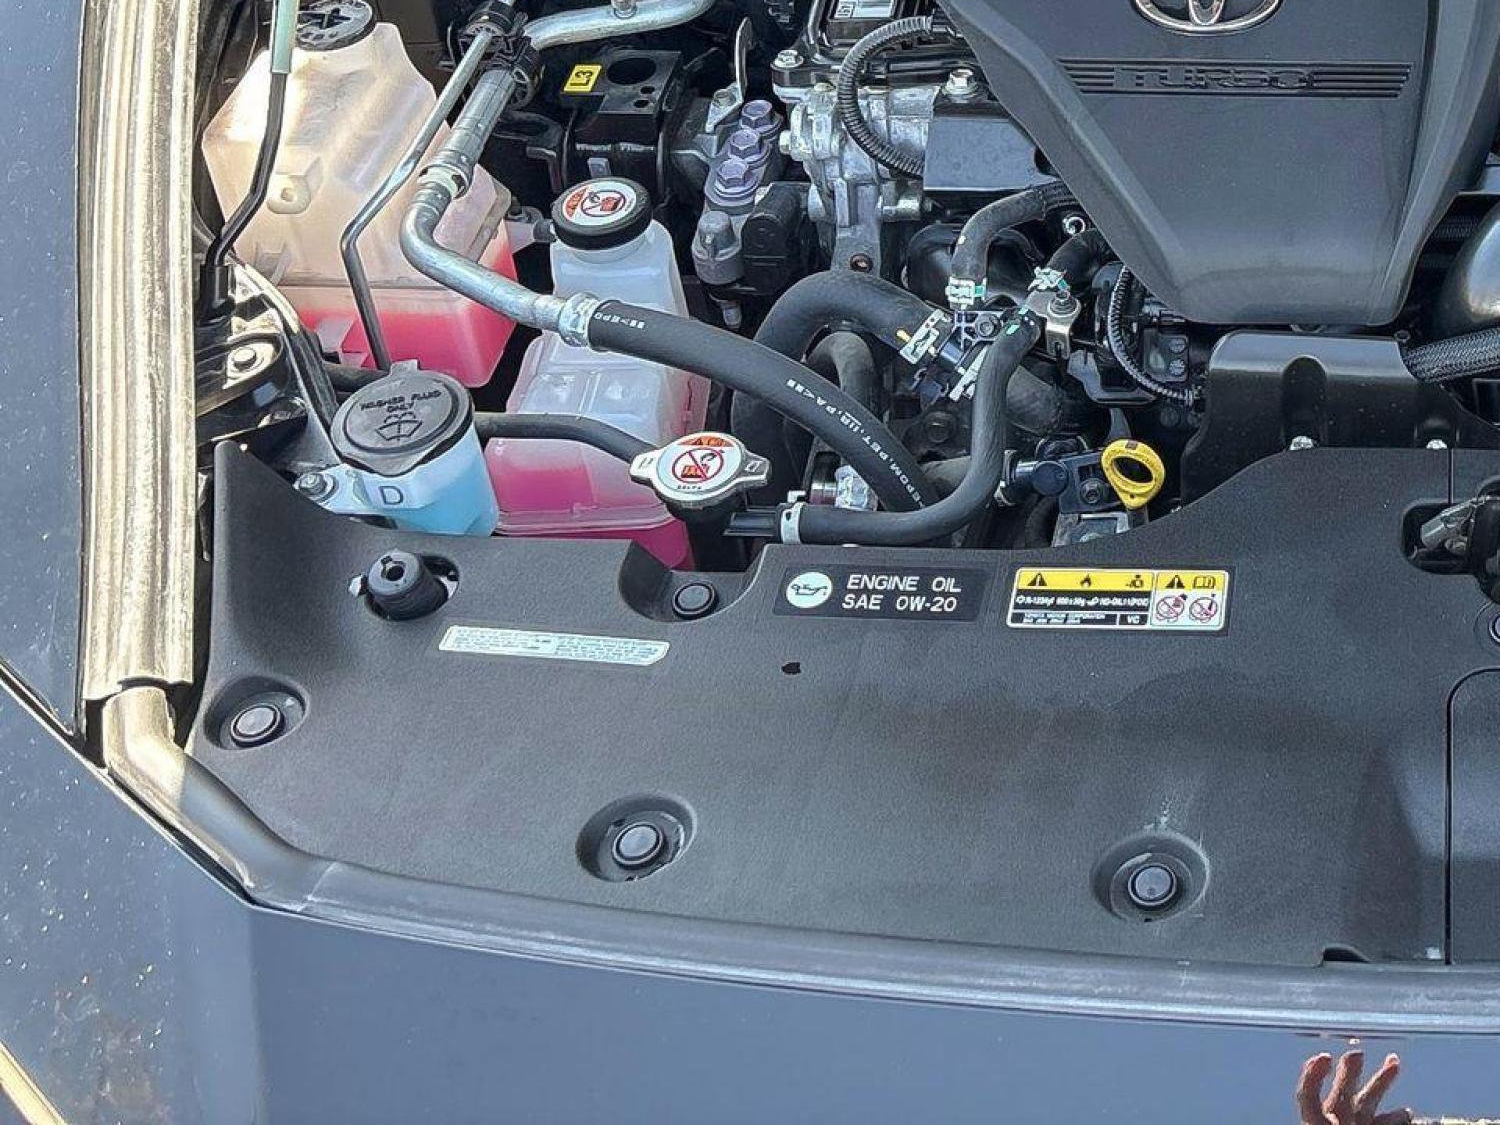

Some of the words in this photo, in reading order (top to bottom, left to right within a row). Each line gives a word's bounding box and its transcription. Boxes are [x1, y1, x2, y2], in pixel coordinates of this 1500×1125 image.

[569, 70, 594, 87] L3
[379, 485, 404, 506] D
[846, 574, 918, 592] ENGINE
[931, 576, 962, 593] OIL
[841, 593, 882, 611] SAE
[895, 594, 958, 612] 0W-20
